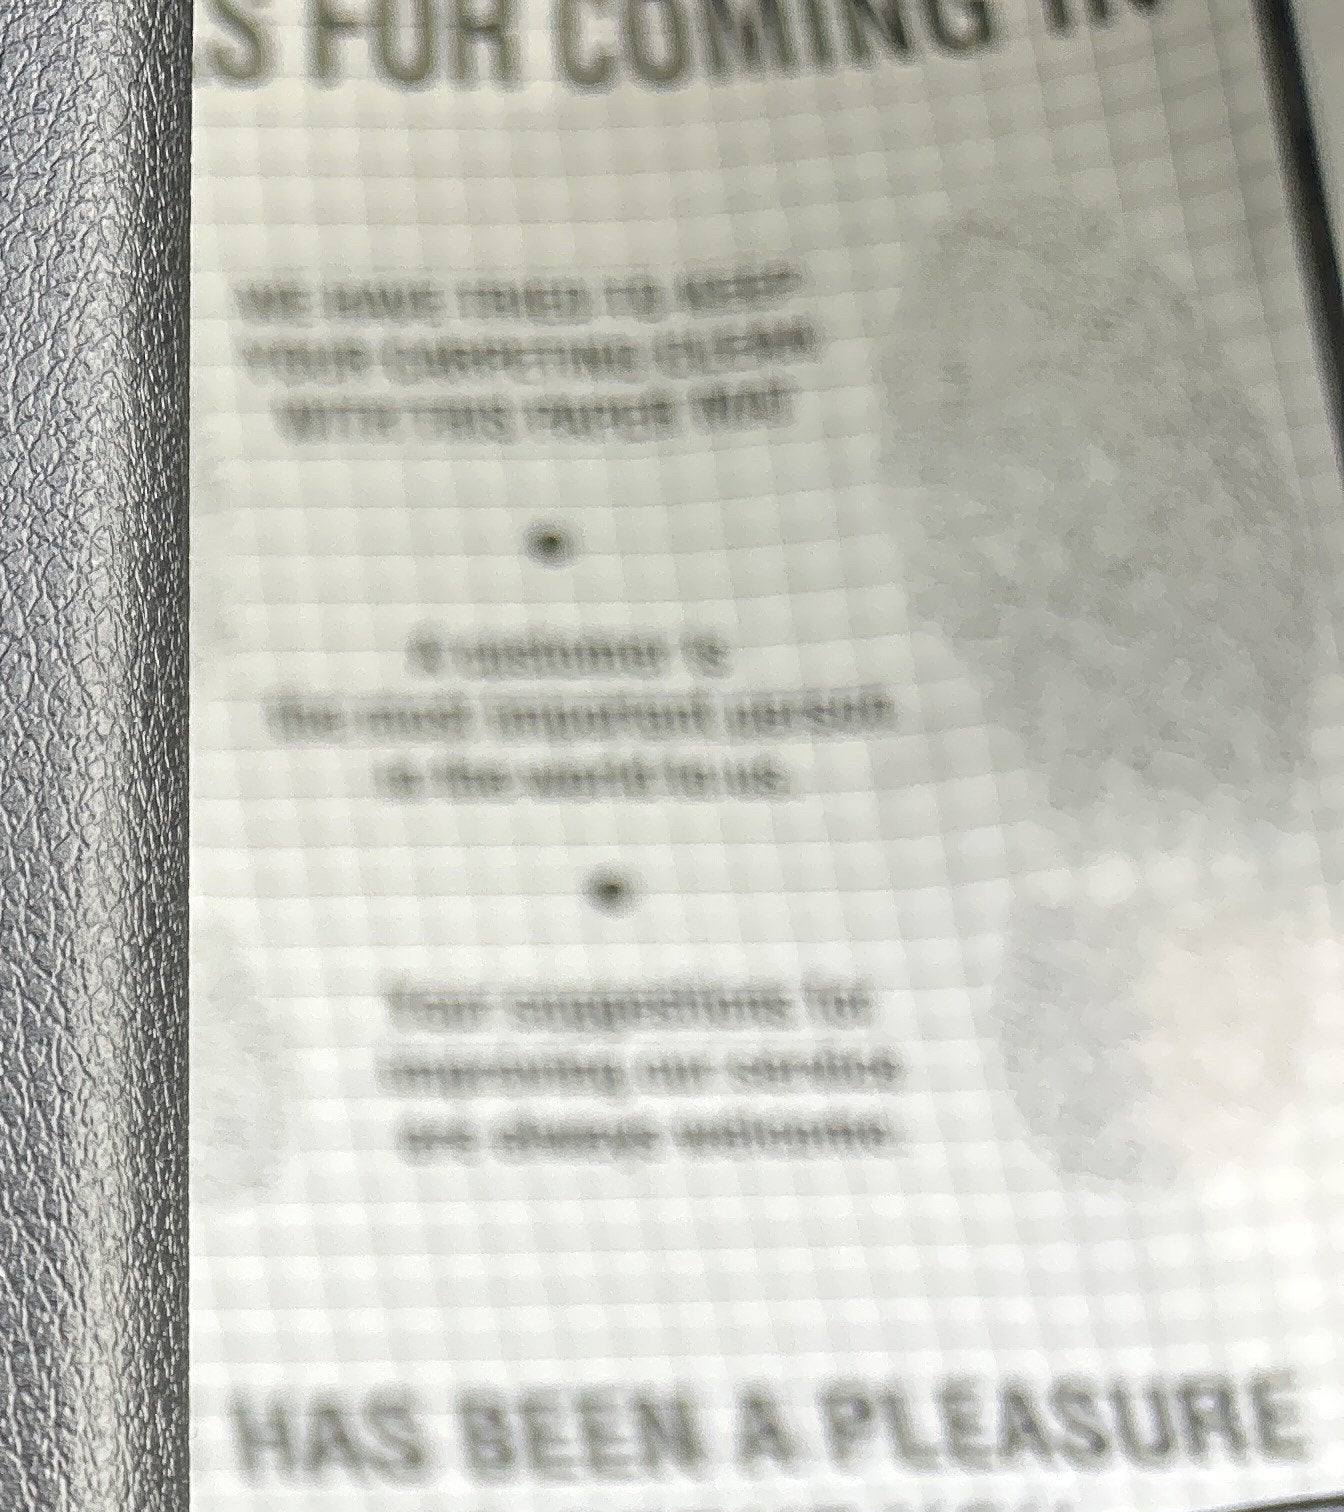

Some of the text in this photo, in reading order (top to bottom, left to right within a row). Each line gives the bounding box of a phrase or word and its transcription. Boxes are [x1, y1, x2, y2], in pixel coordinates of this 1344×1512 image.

[227, 1370, 1314, 1480] HAS BEEN A PLEASURE
